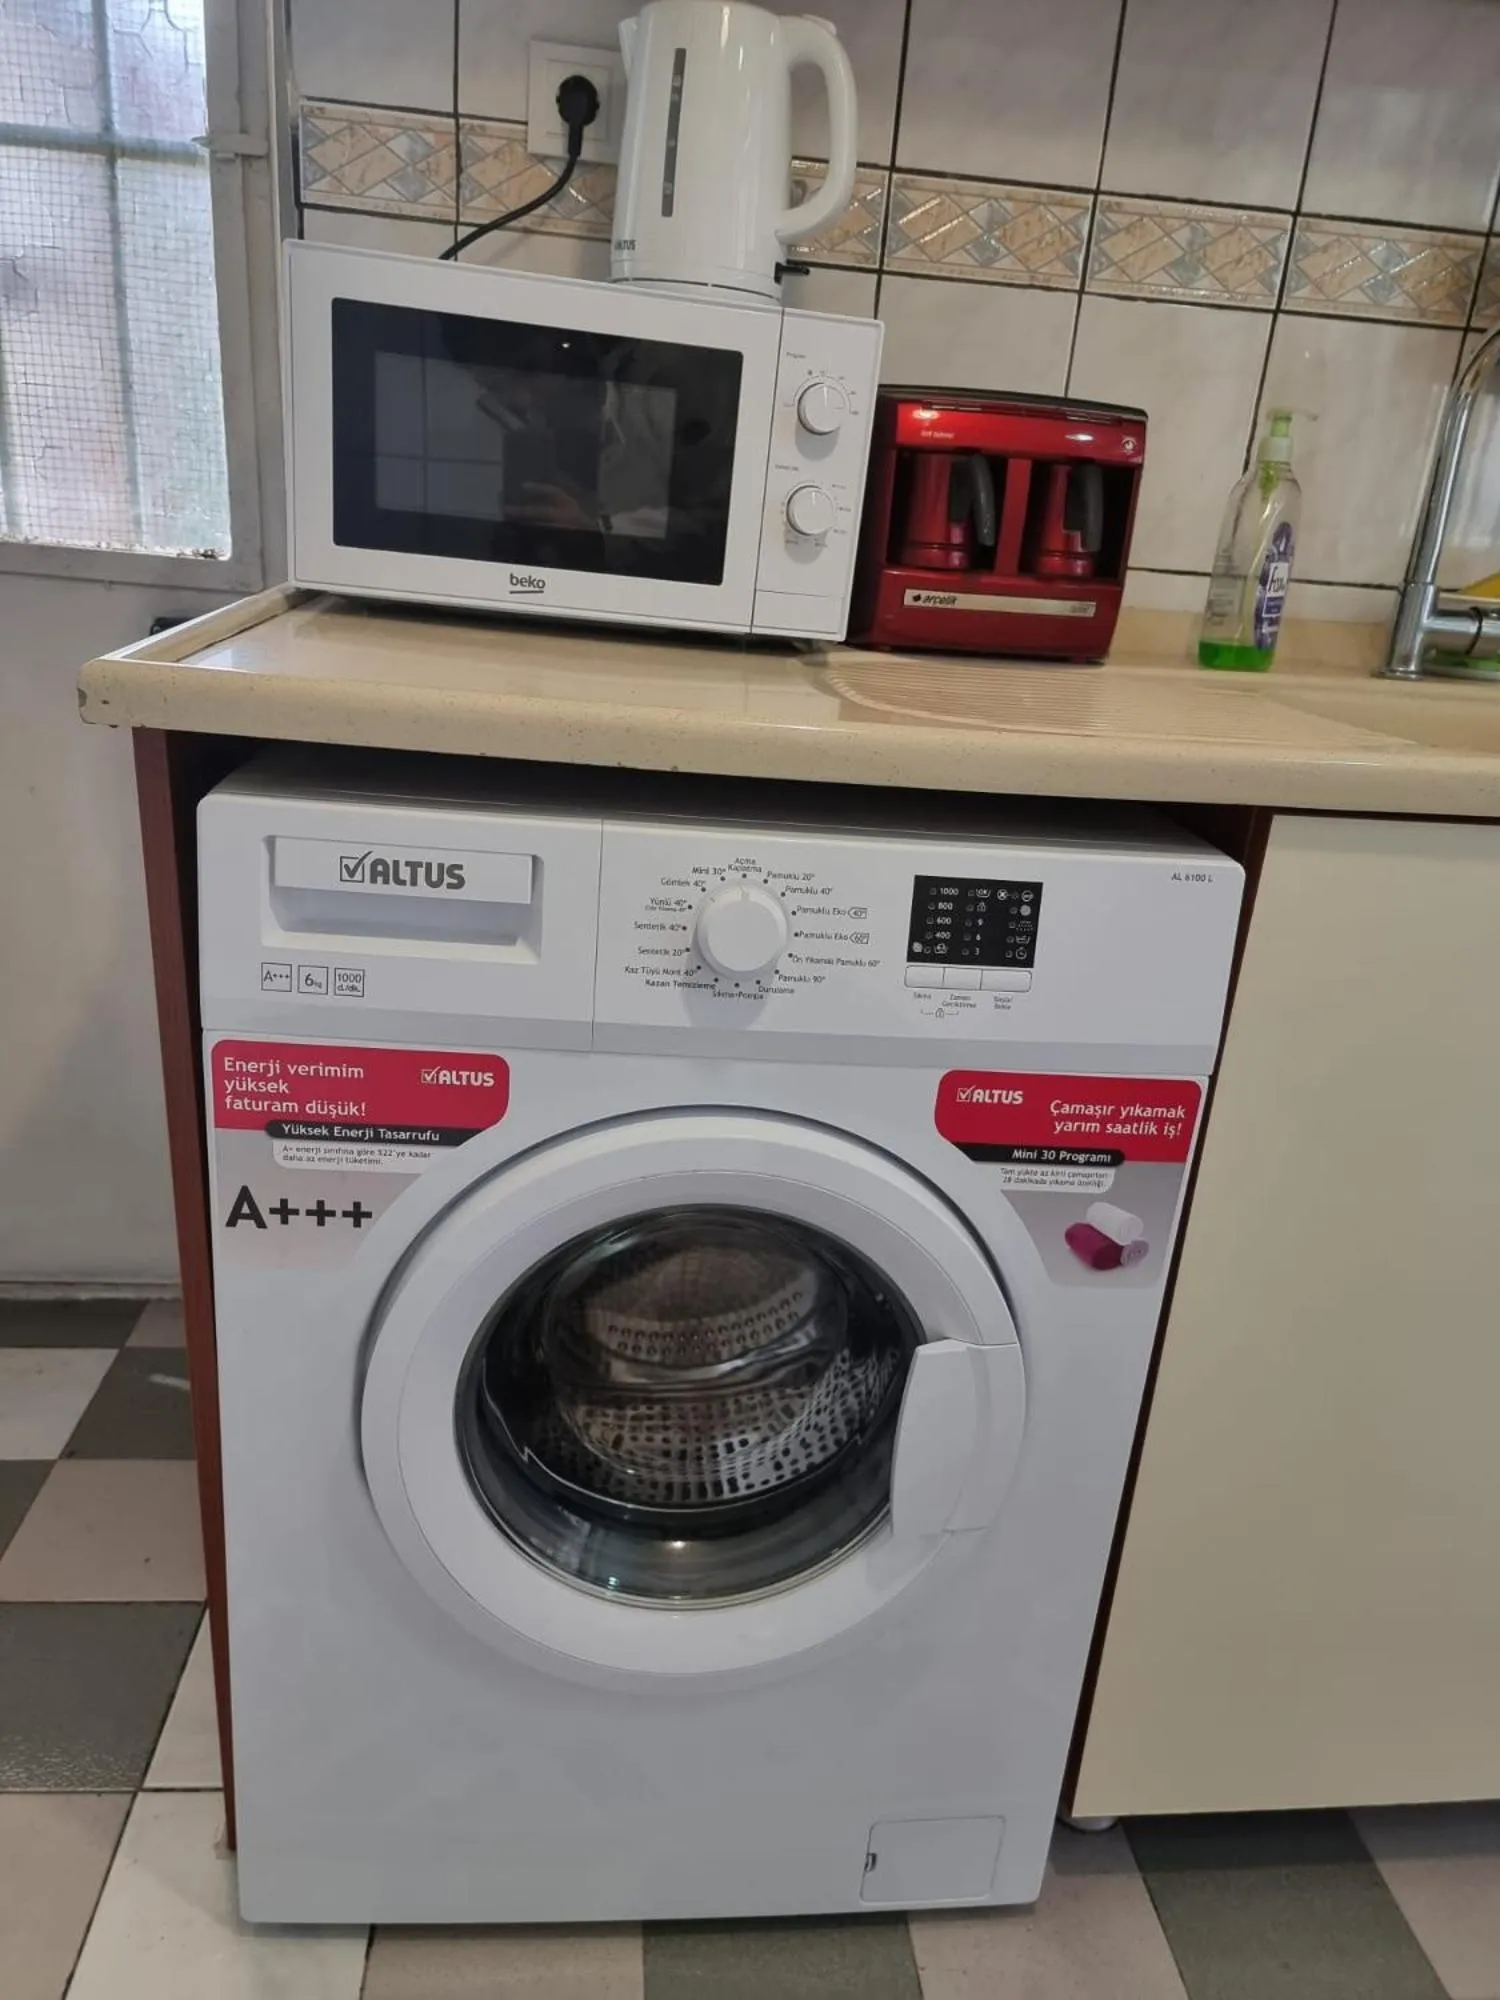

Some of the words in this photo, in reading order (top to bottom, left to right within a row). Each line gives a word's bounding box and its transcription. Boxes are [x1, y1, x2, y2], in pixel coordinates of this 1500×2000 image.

[509, 572, 546, 589] beko
[369, 857, 466, 890] ALTUS
[1171, 871, 1182, 881] AL
[940, 887, 960, 896] 1000
[938, 901, 954, 911] 800
[936, 916, 952, 925] 600
[935, 931, 951, 940] 400
[264, 970, 291, 982] A+++
[337, 972, 363, 983] 1000
[223, 1056, 281, 1076] Enerji
[288, 1063, 365, 1079] verimim
[223, 1077, 290, 1094] yüksek
[439, 1071, 495, 1086] ALTUS
[971, 1088, 1024, 1105] ALTUS
[224, 1096, 299, 1114] faturam
[305, 1099, 367, 1118] düşük!
[1050, 1099, 1116, 1118] Çamaşır
[1119, 1103, 1186, 1120] yıkamak
[281, 1123, 330, 1137] Yüksek
[333, 1126, 374, 1140] Enerji
[378, 1128, 440, 1142] Tasarrufu
[1053, 1120, 1101, 1135] yarım
[1105, 1121, 1158, 1136] saatlik
[1163, 1121, 1182, 1139] iş!
[1011, 1149, 1037, 1160] Mini
[1041, 1150, 1056, 1160] 30
[1059, 1151, 1112, 1164] Programı
[225, 1184, 373, 1230] A+++
